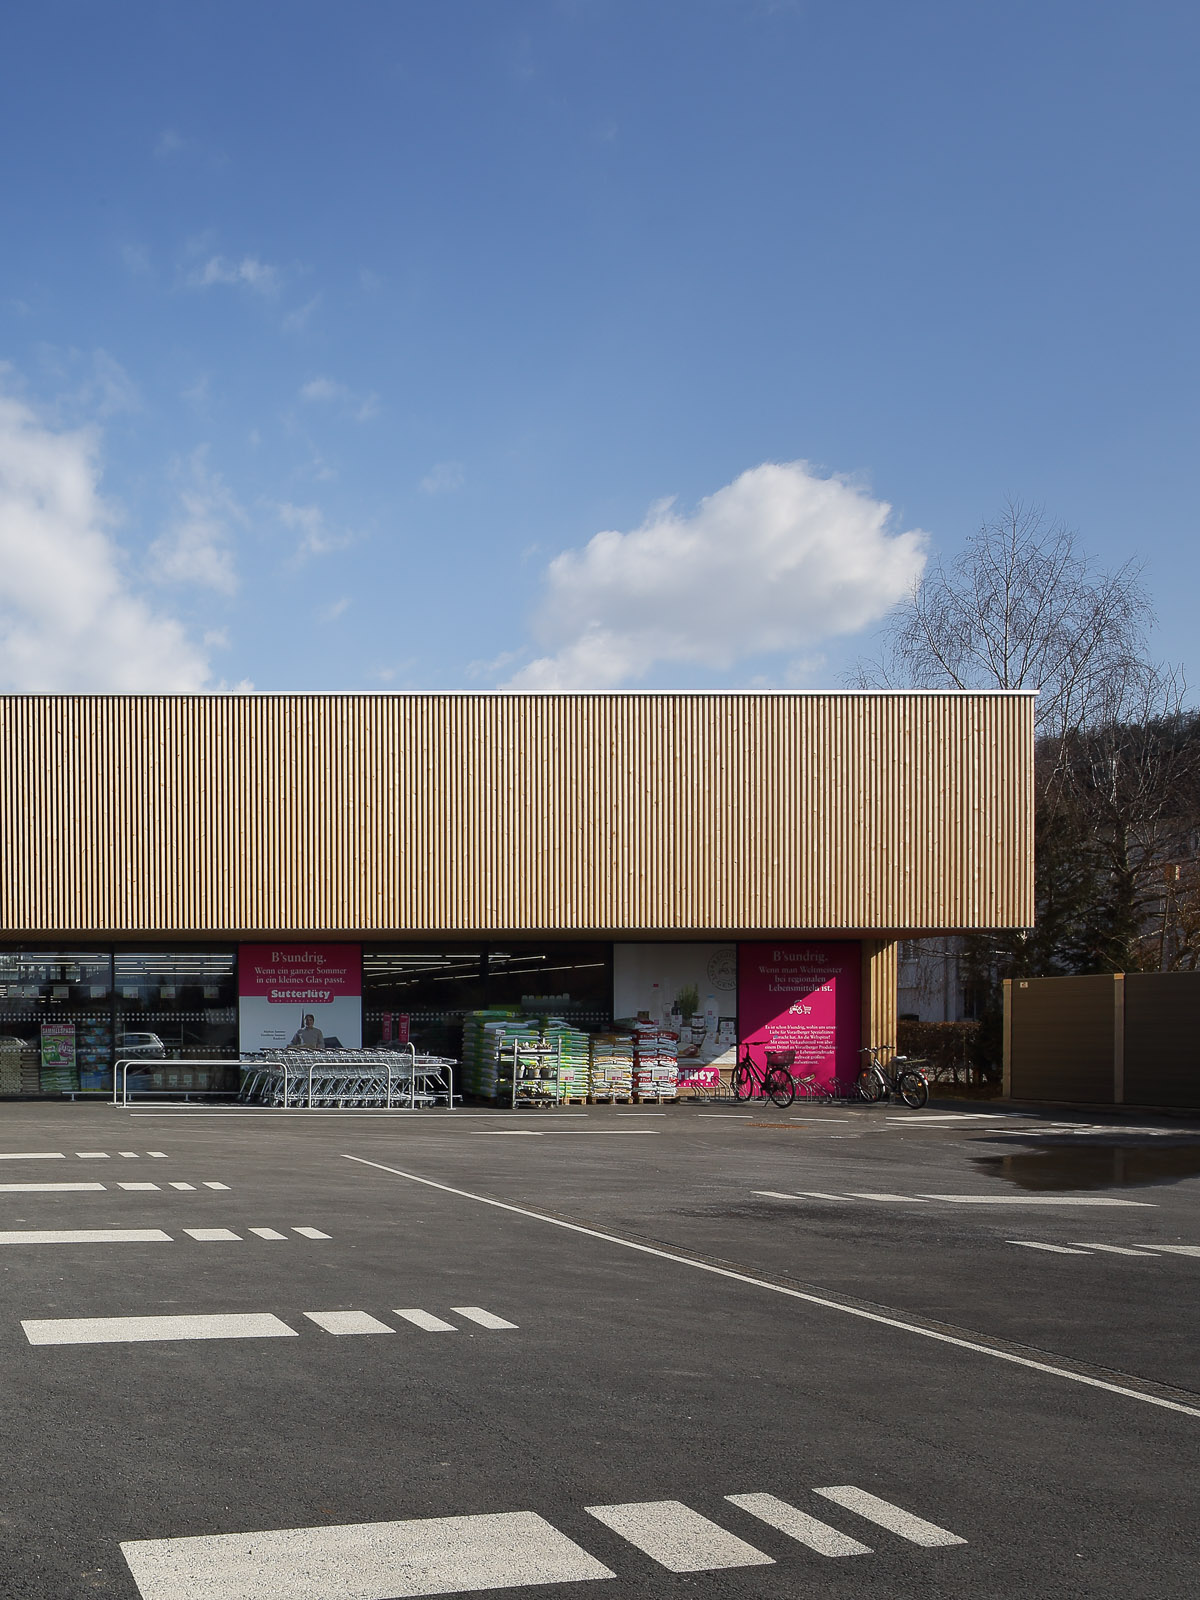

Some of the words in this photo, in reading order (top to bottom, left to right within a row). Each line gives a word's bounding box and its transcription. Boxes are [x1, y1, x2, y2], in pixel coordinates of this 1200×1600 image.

[271, 951, 327, 965] B'sundrig.
[773, 950, 828, 963] B'sundrig.
[254, 967, 275, 975] Wenn
[278, 967, 288, 975] ein
[316, 967, 346, 975] Sommer
[256, 976, 263, 984] in
[266, 976, 276, 984] ein
[278, 976, 303, 984] kleines
[305, 976, 322, 984] Glas
[324, 977, 345, 985] passt.
[788, 975, 826, 983] regionalen
[271, 989, 330, 999] Sutterlüty
